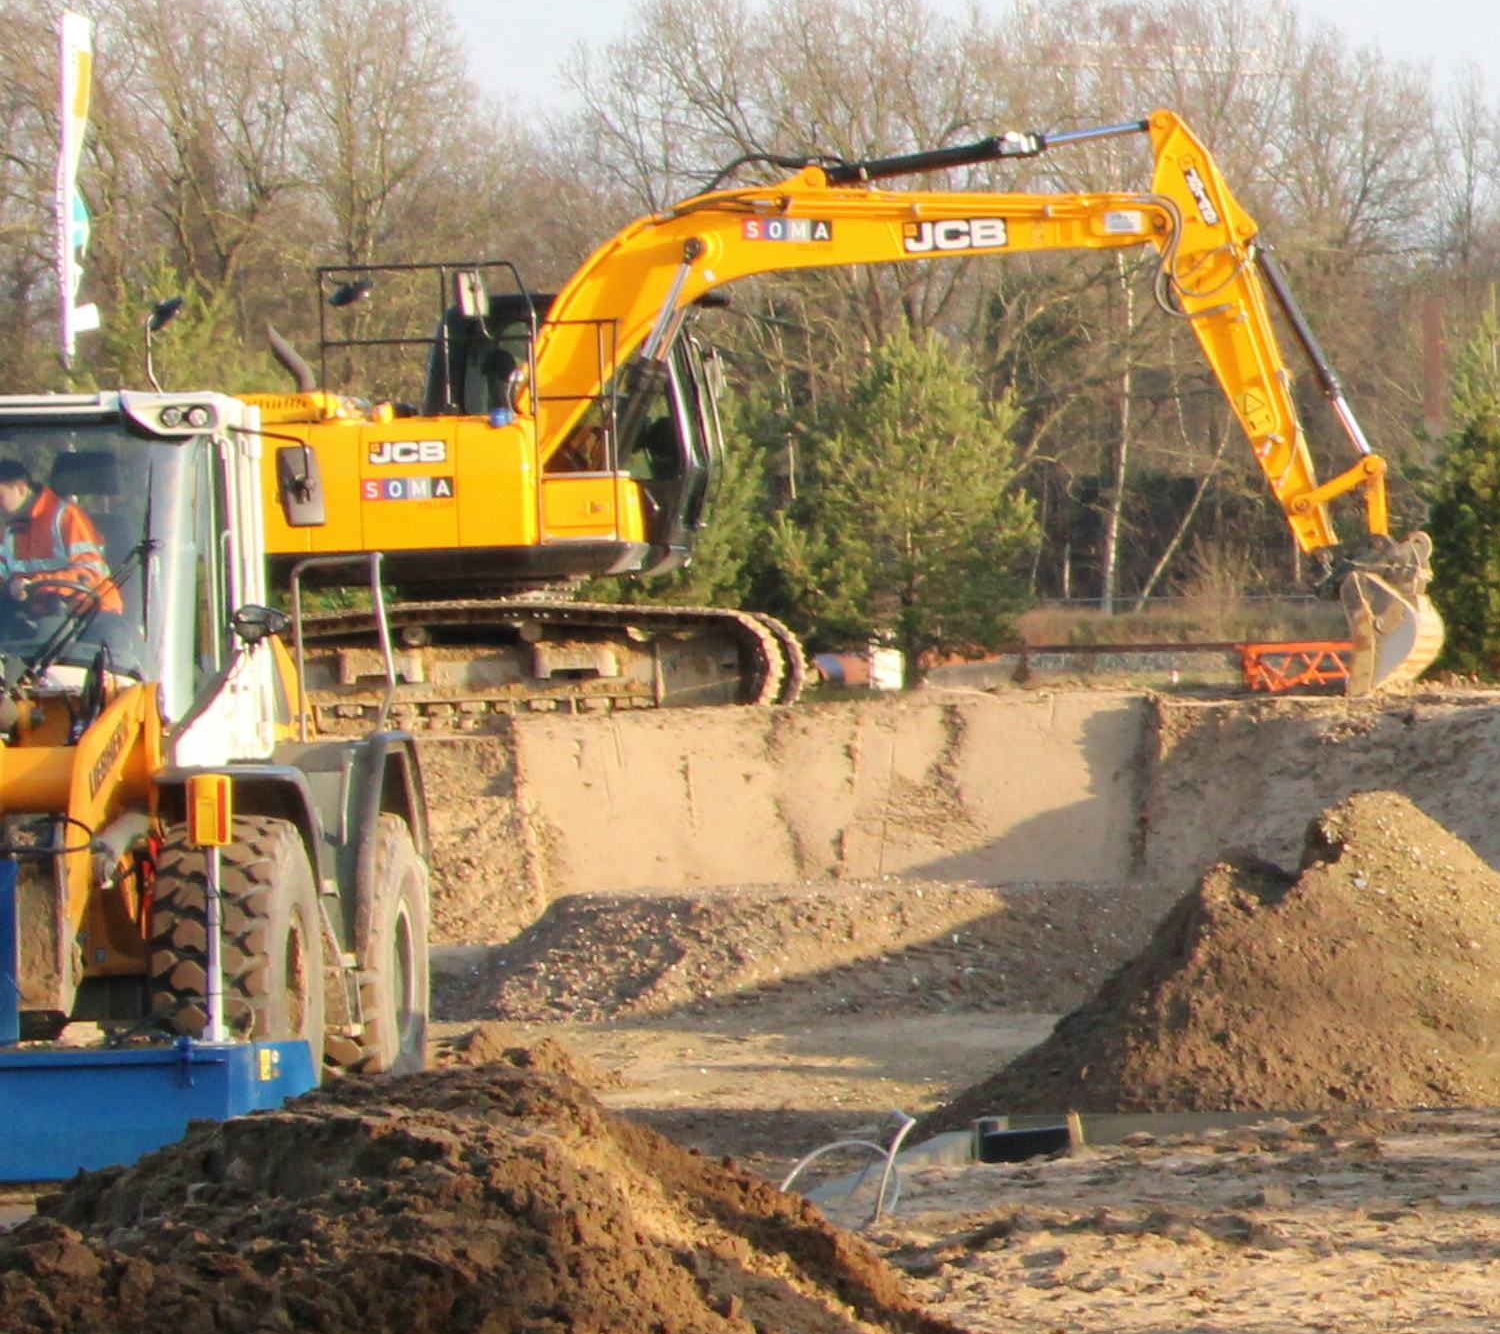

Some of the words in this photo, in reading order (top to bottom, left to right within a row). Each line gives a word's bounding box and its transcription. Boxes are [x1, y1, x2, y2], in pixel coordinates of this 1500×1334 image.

[745, 220, 830, 240] SOMA
[904, 218, 1007, 252] JCB
[369, 440, 446, 464] JCB
[365, 478, 452, 499] SOMA
